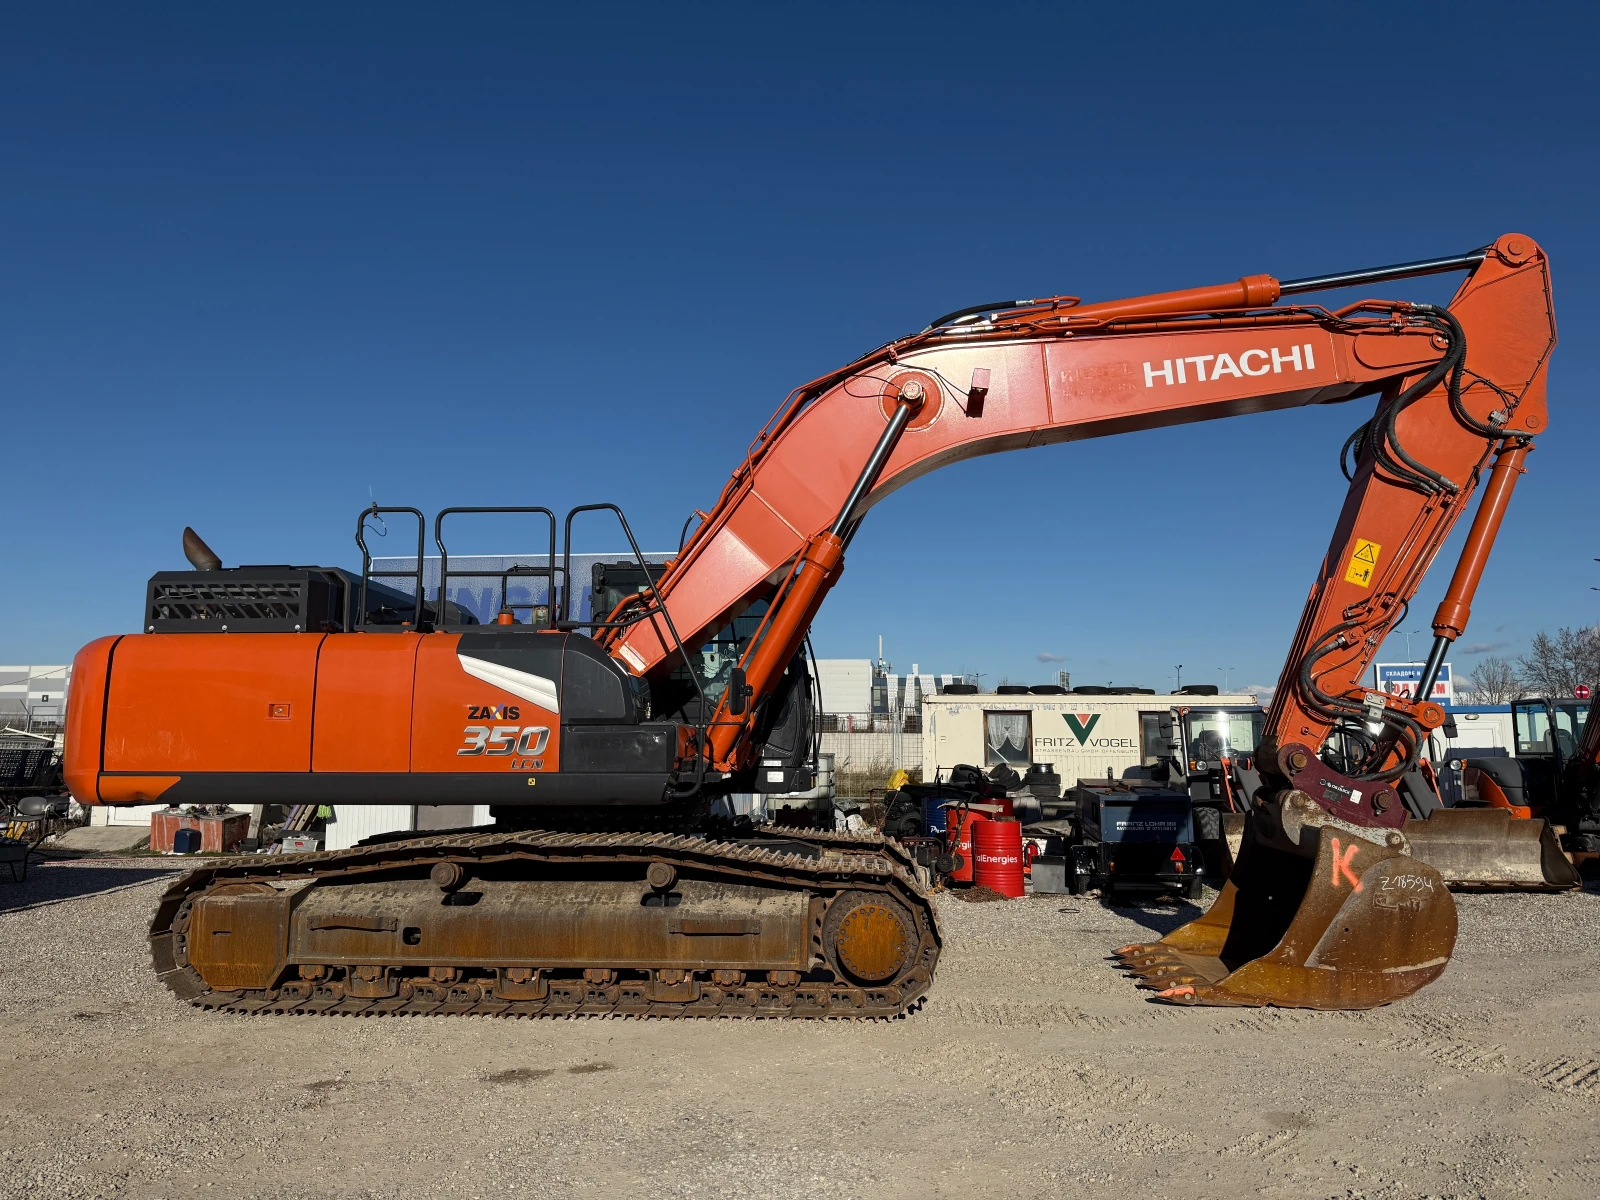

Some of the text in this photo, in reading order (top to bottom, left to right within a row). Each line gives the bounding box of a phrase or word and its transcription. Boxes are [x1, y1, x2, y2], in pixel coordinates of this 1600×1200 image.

[1142, 343, 1316, 388] HITACHI
[467, 703, 521, 720] ZAXIS
[456, 725, 551, 756] 350
[1034, 737, 1138, 748] FRITZ VOGEL
[510, 758, 545, 770] LCN
[1331, 837, 1364, 893] K
[1379, 874, 1435, 893] Z18594
